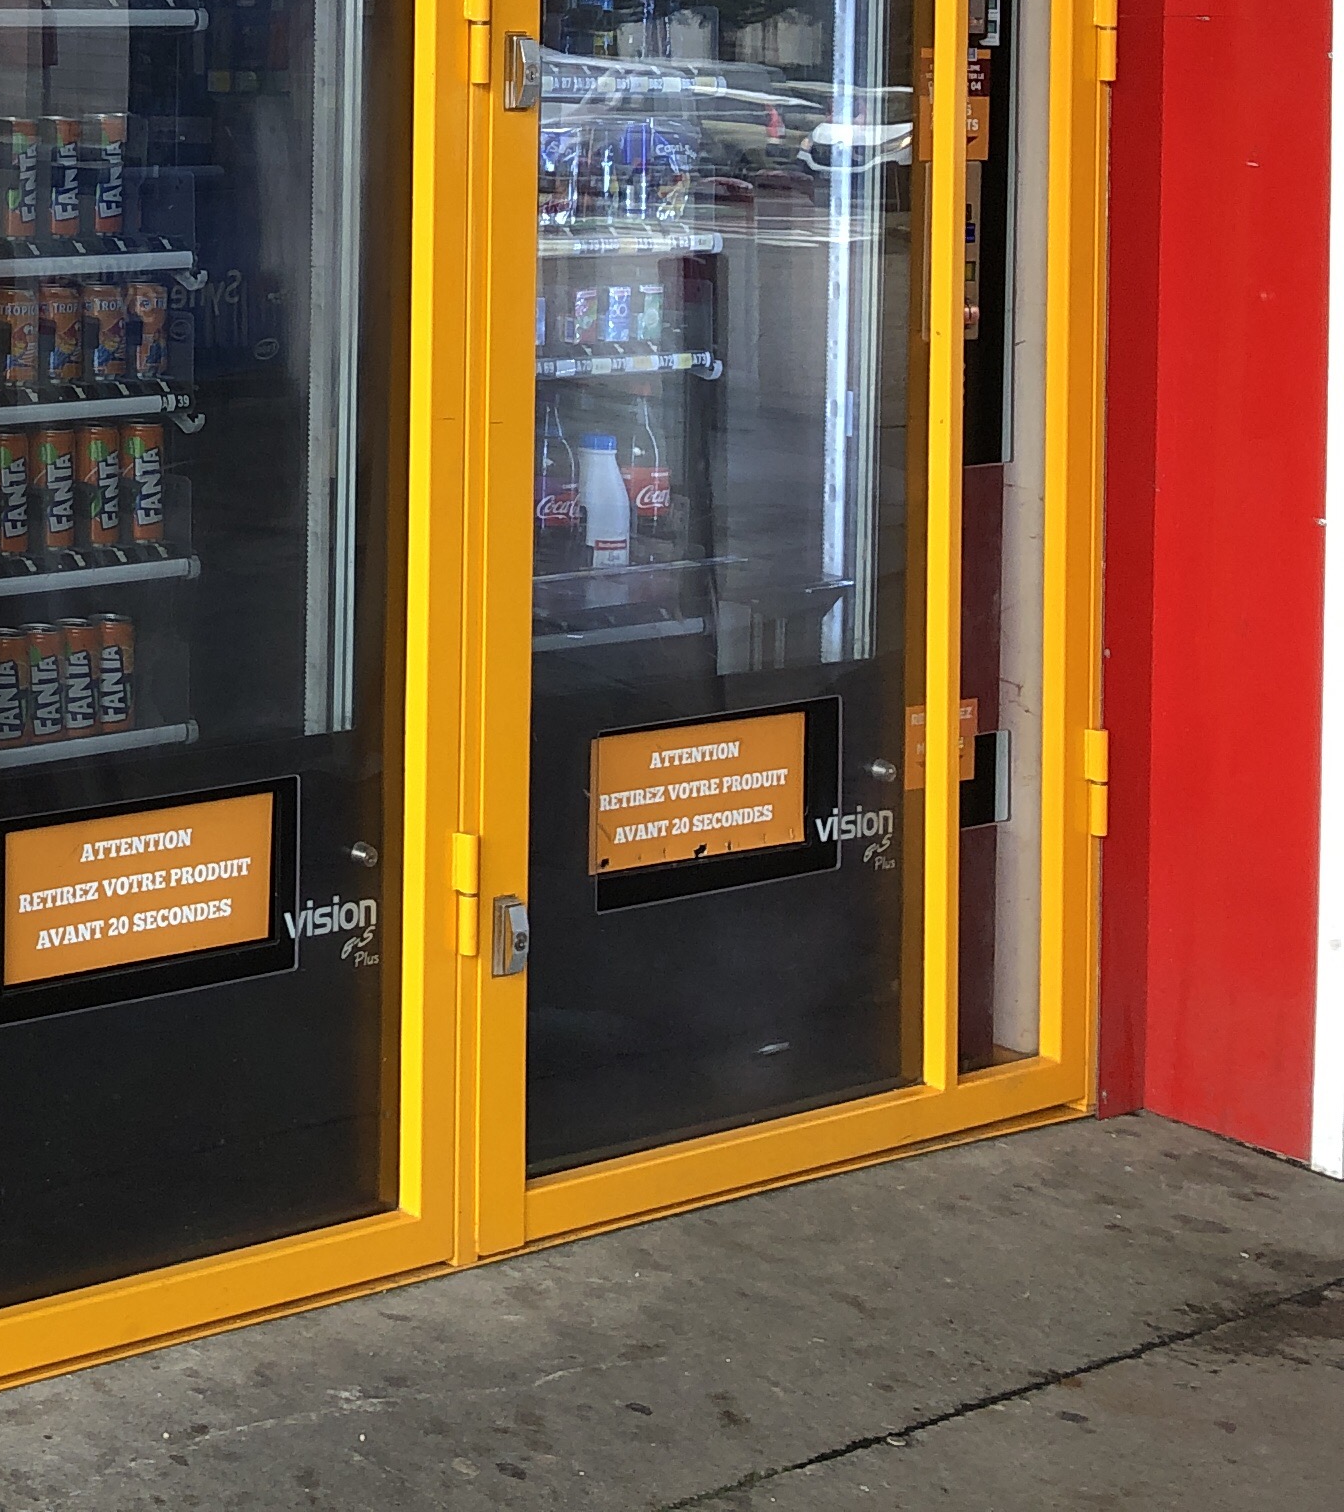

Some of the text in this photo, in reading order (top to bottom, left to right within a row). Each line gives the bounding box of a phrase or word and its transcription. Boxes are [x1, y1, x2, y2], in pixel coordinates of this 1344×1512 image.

[0, 456, 28, 538] FANTA
[47, 451, 75, 533] FANTA
[98, 449, 120, 530] FANTA
[134, 446, 163, 527] FANTA
[30, 655, 62, 736] FANTA
[65, 650, 95, 731] FANTA
[100, 644, 128, 723] FANTA
[649, 741, 740, 769] ATTENTION
[599, 768, 788, 812] RETIREZ VOTRE PRODUIT
[80, 828, 192, 863] ATTENTION
[614, 804, 773, 844] AVANT 20 SECONDES
[815, 805, 894, 843] vision
[19, 857, 251, 914] RETIREZ VOTRE PRODUIT
[874, 856, 896, 872] Plus
[36, 898, 232, 950] AVANT 20 SECONDES
[284, 895, 377, 940] vision
[354, 950, 381, 968] Plus
